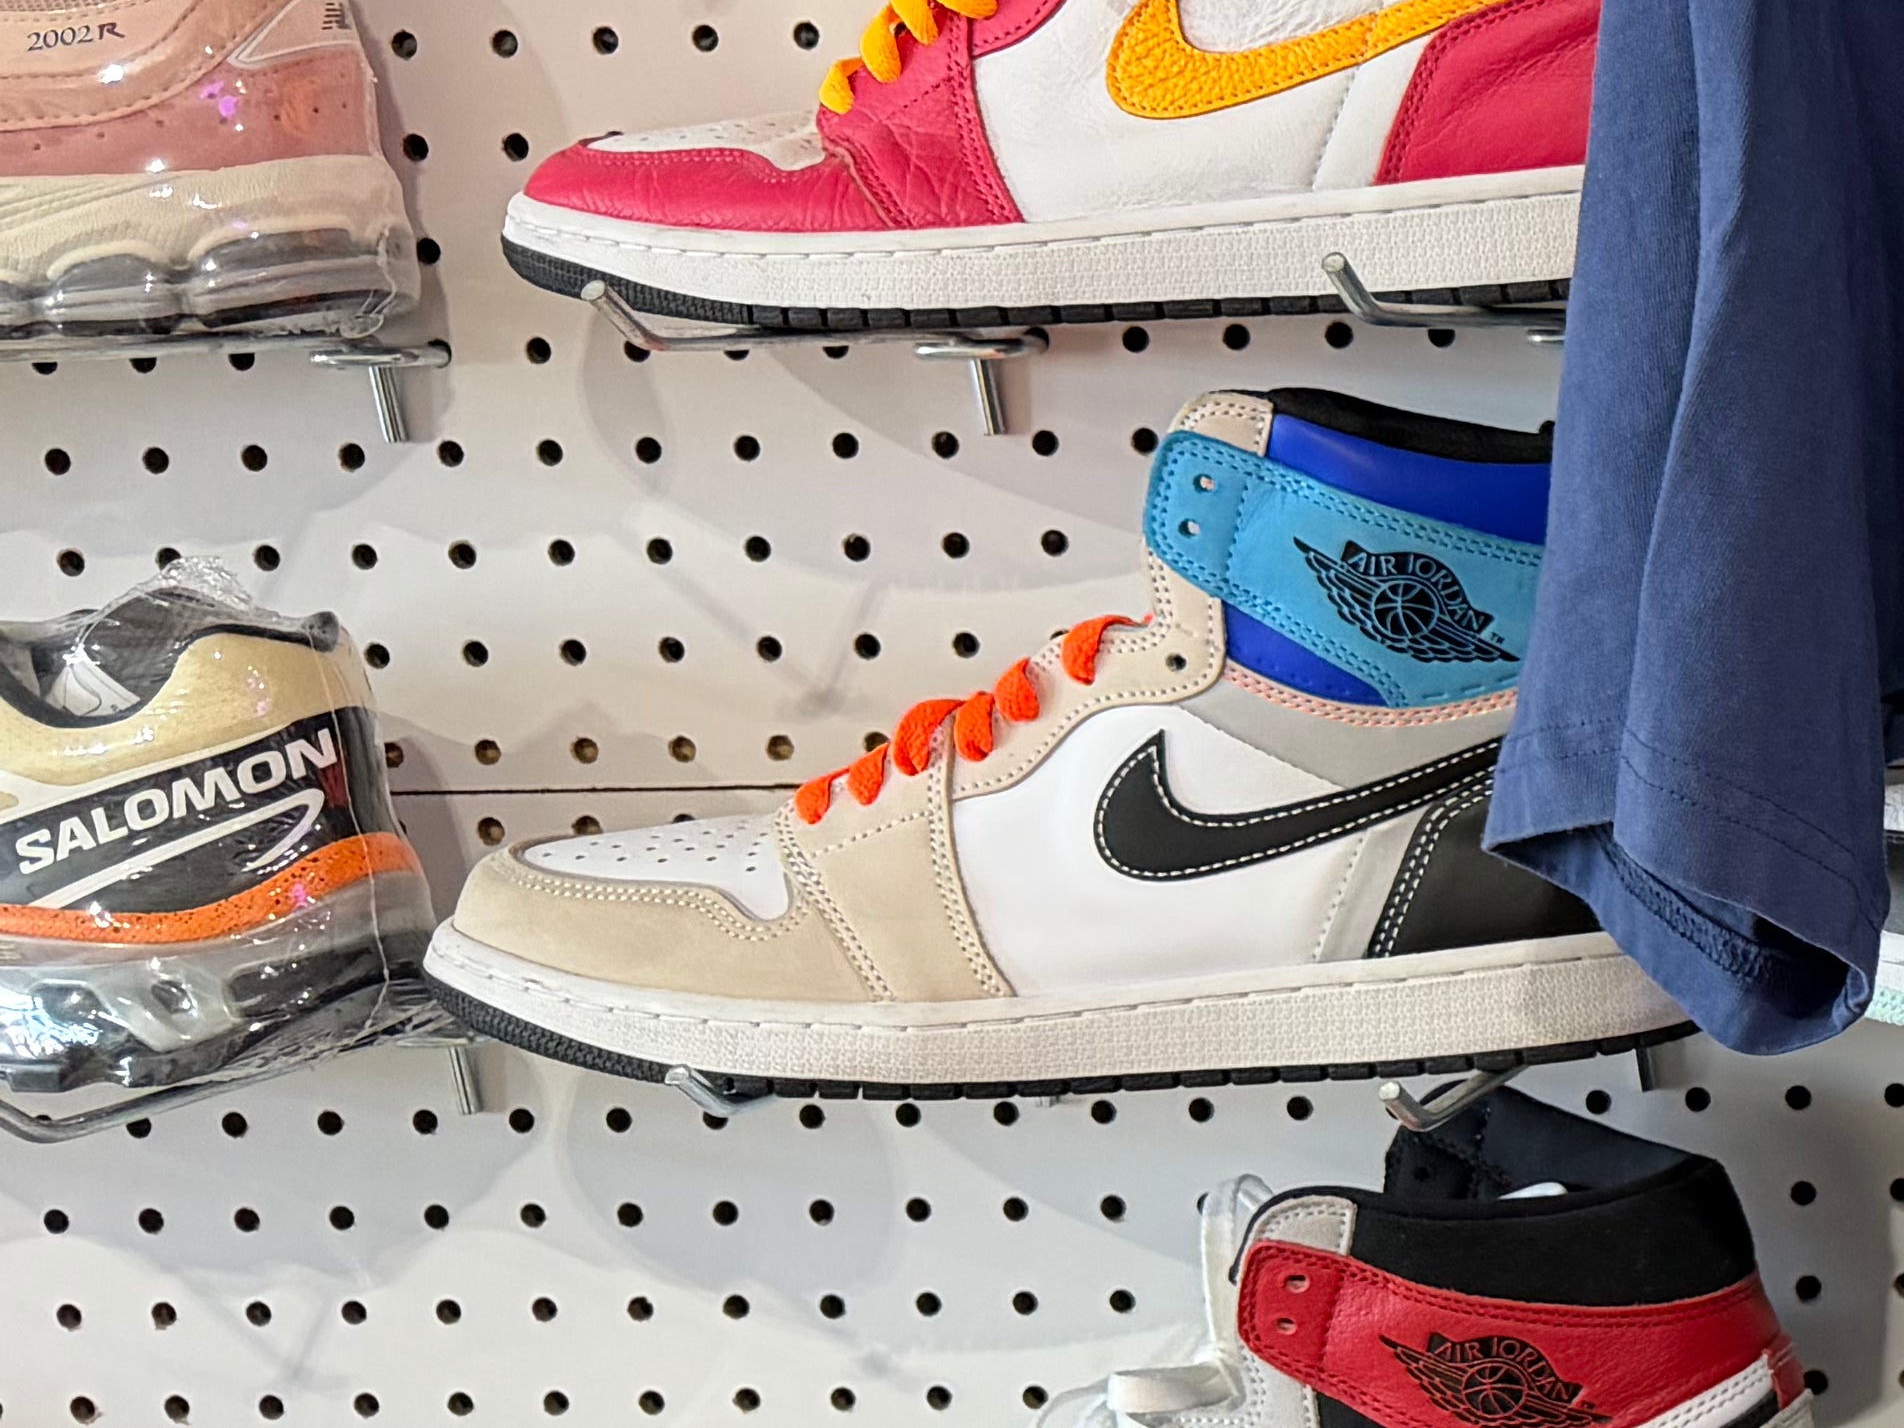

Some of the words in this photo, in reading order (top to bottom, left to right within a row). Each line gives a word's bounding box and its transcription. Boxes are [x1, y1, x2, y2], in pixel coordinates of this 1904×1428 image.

[1349, 552, 1398, 575] AIR
[1408, 553, 1486, 631] JORDAN
[16, 728, 338, 874] SALOMON
[1434, 1341, 1483, 1363] AIR
[1491, 1336, 1574, 1401] JORDAN
